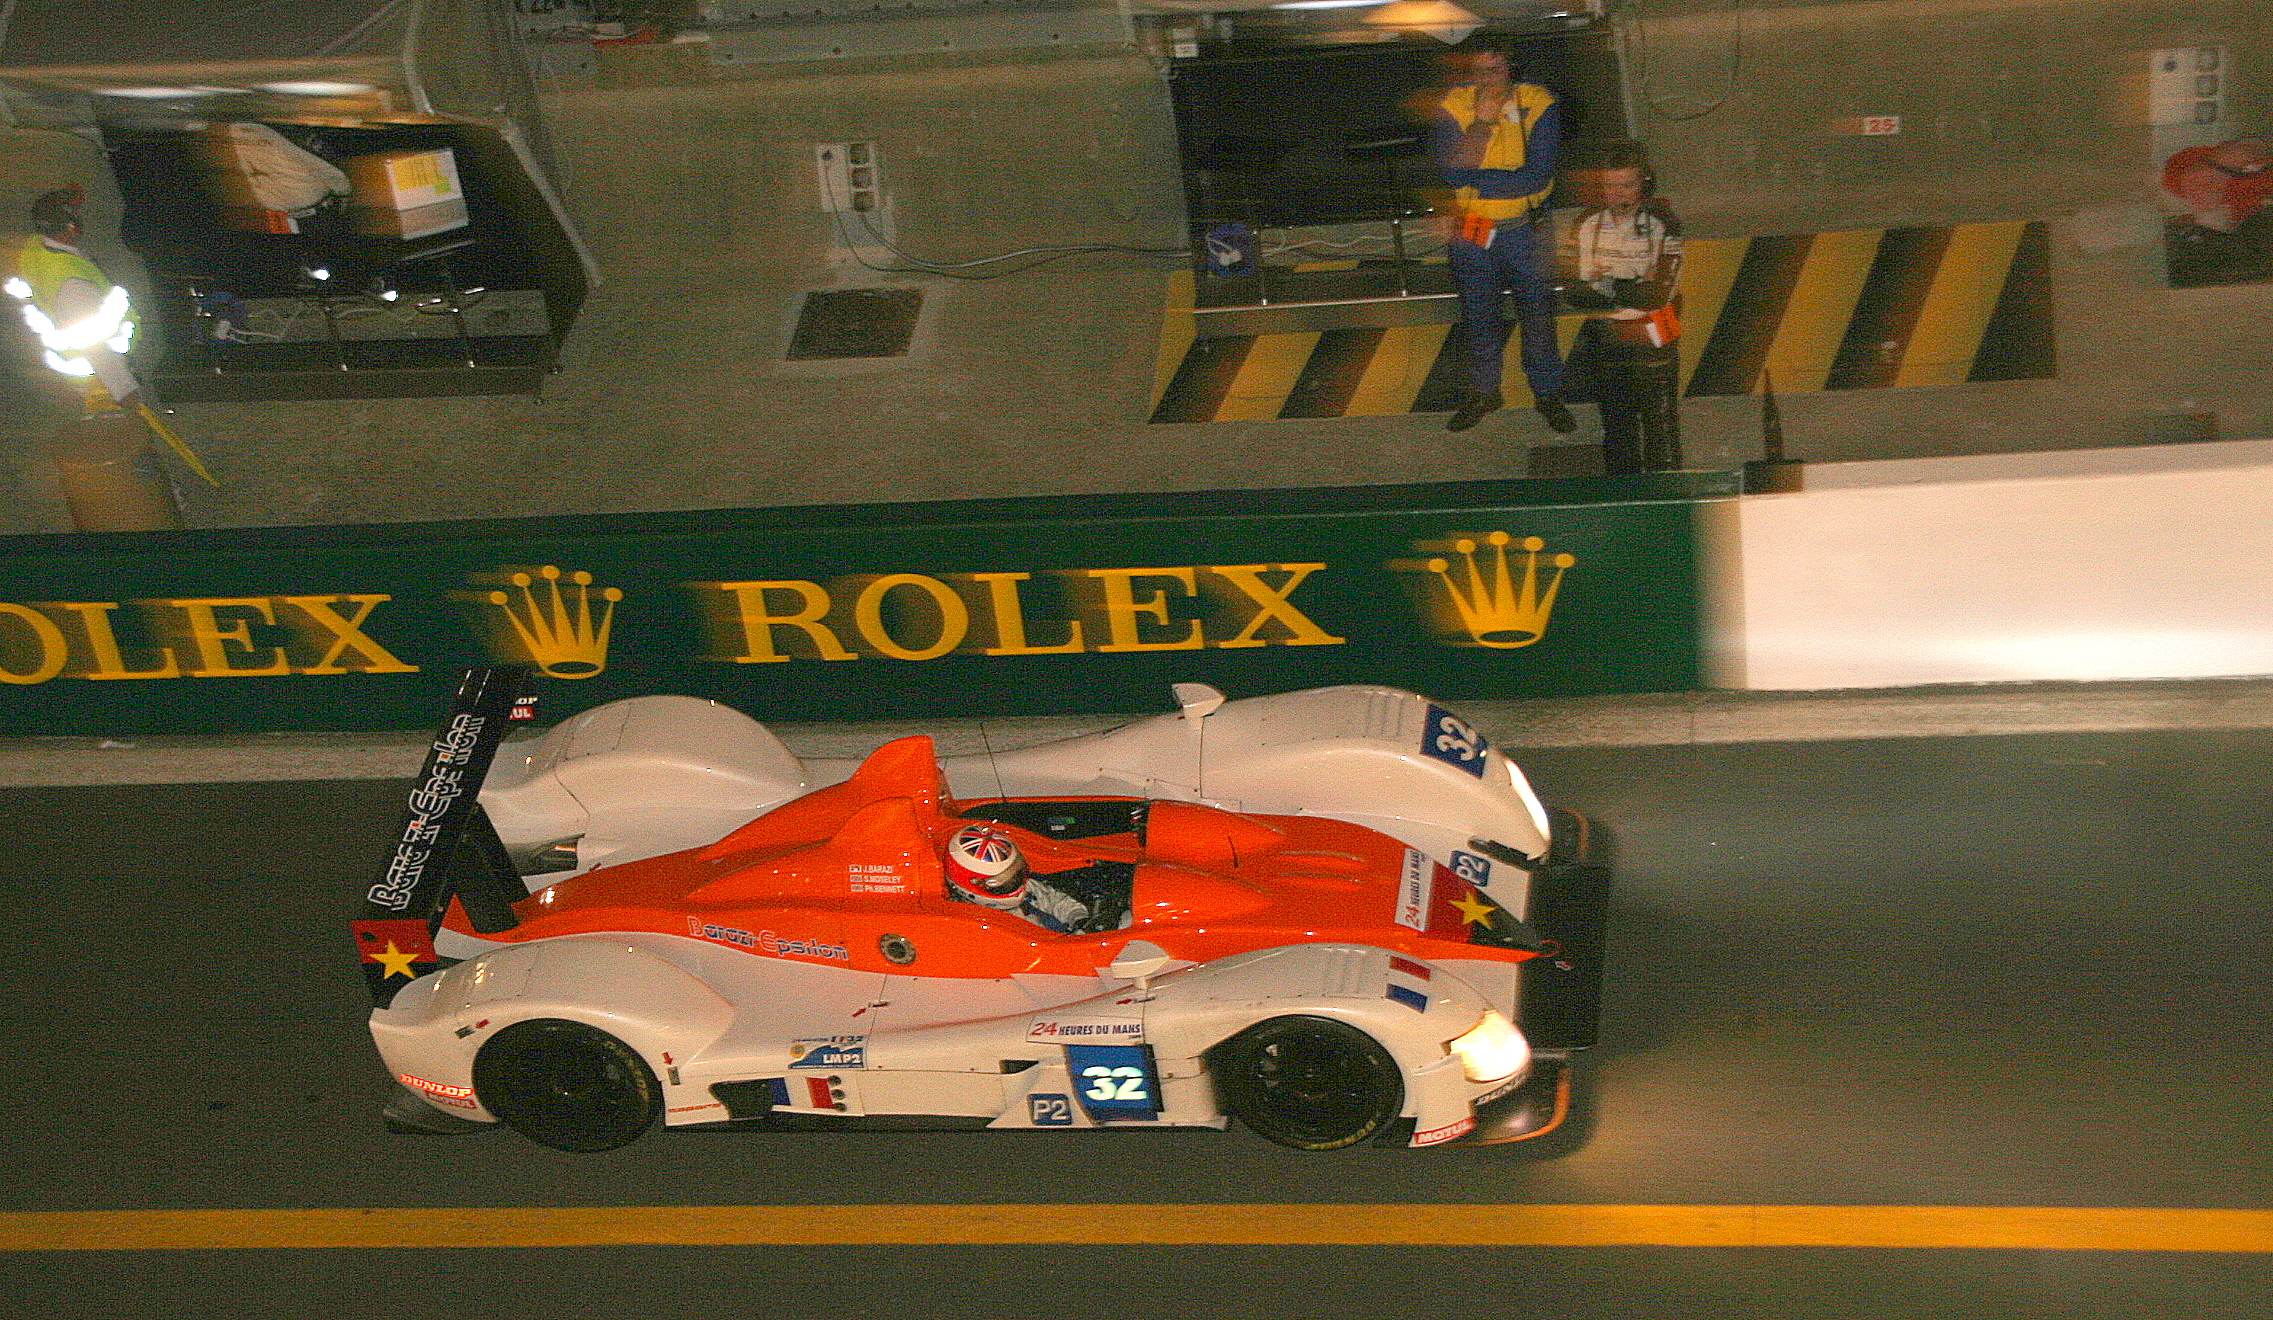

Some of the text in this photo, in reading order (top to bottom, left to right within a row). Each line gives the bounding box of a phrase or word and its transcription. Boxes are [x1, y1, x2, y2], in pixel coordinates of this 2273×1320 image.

[721, 562, 1345, 664] ROLEX
[1436, 716, 1478, 761] 32
[1456, 855, 1485, 885] P2
[1031, 1022, 1141, 1036] 24 HEURES DU MANS
[823, 1054, 862, 1064] LMP2
[401, 1074, 472, 1097] DUNLOP
[1082, 1066, 1147, 1100] 32
[1033, 1099, 1069, 1120] P2
